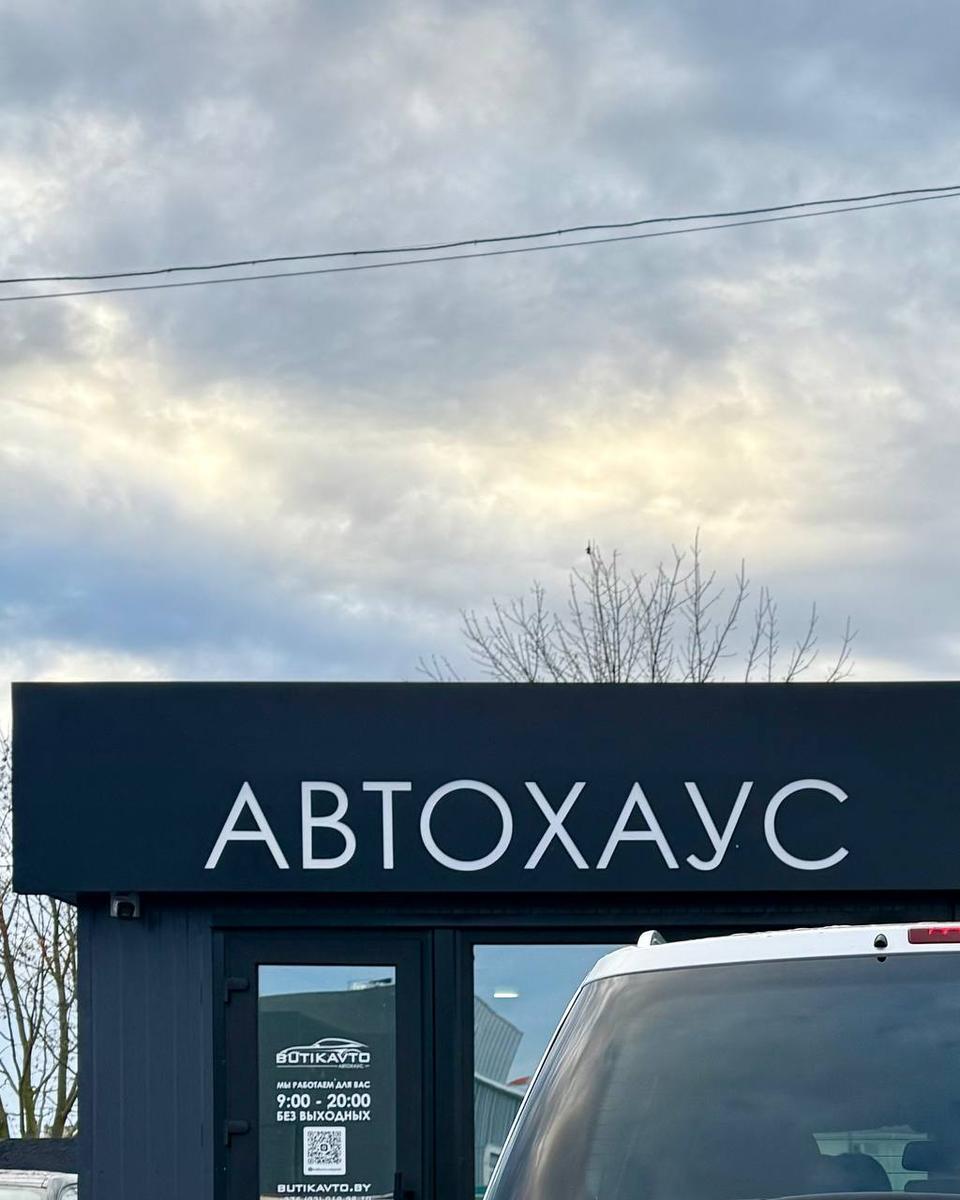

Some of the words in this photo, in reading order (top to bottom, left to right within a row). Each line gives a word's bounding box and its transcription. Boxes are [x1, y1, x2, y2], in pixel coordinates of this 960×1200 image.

[204, 778, 850, 872] АВТОХАУС
[275, 1052, 371, 1064] BUTIKAVTO
[276, 1081, 291, 1089] МЫ
[292, 1081, 335, 1089] РАБОТАЕМ
[335, 1081, 352, 1090] ДЛЯ
[353, 1081, 371, 1089] ВАС
[276, 1093, 311, 1108] 9:00
[327, 1093, 371, 1109] 20:00
[276, 1110, 296, 1121] БЕЗ
[299, 1110, 371, 1122] ВЫХОДНЫХ
[277, 1183, 371, 1193] BUTIKAVTO.BY
